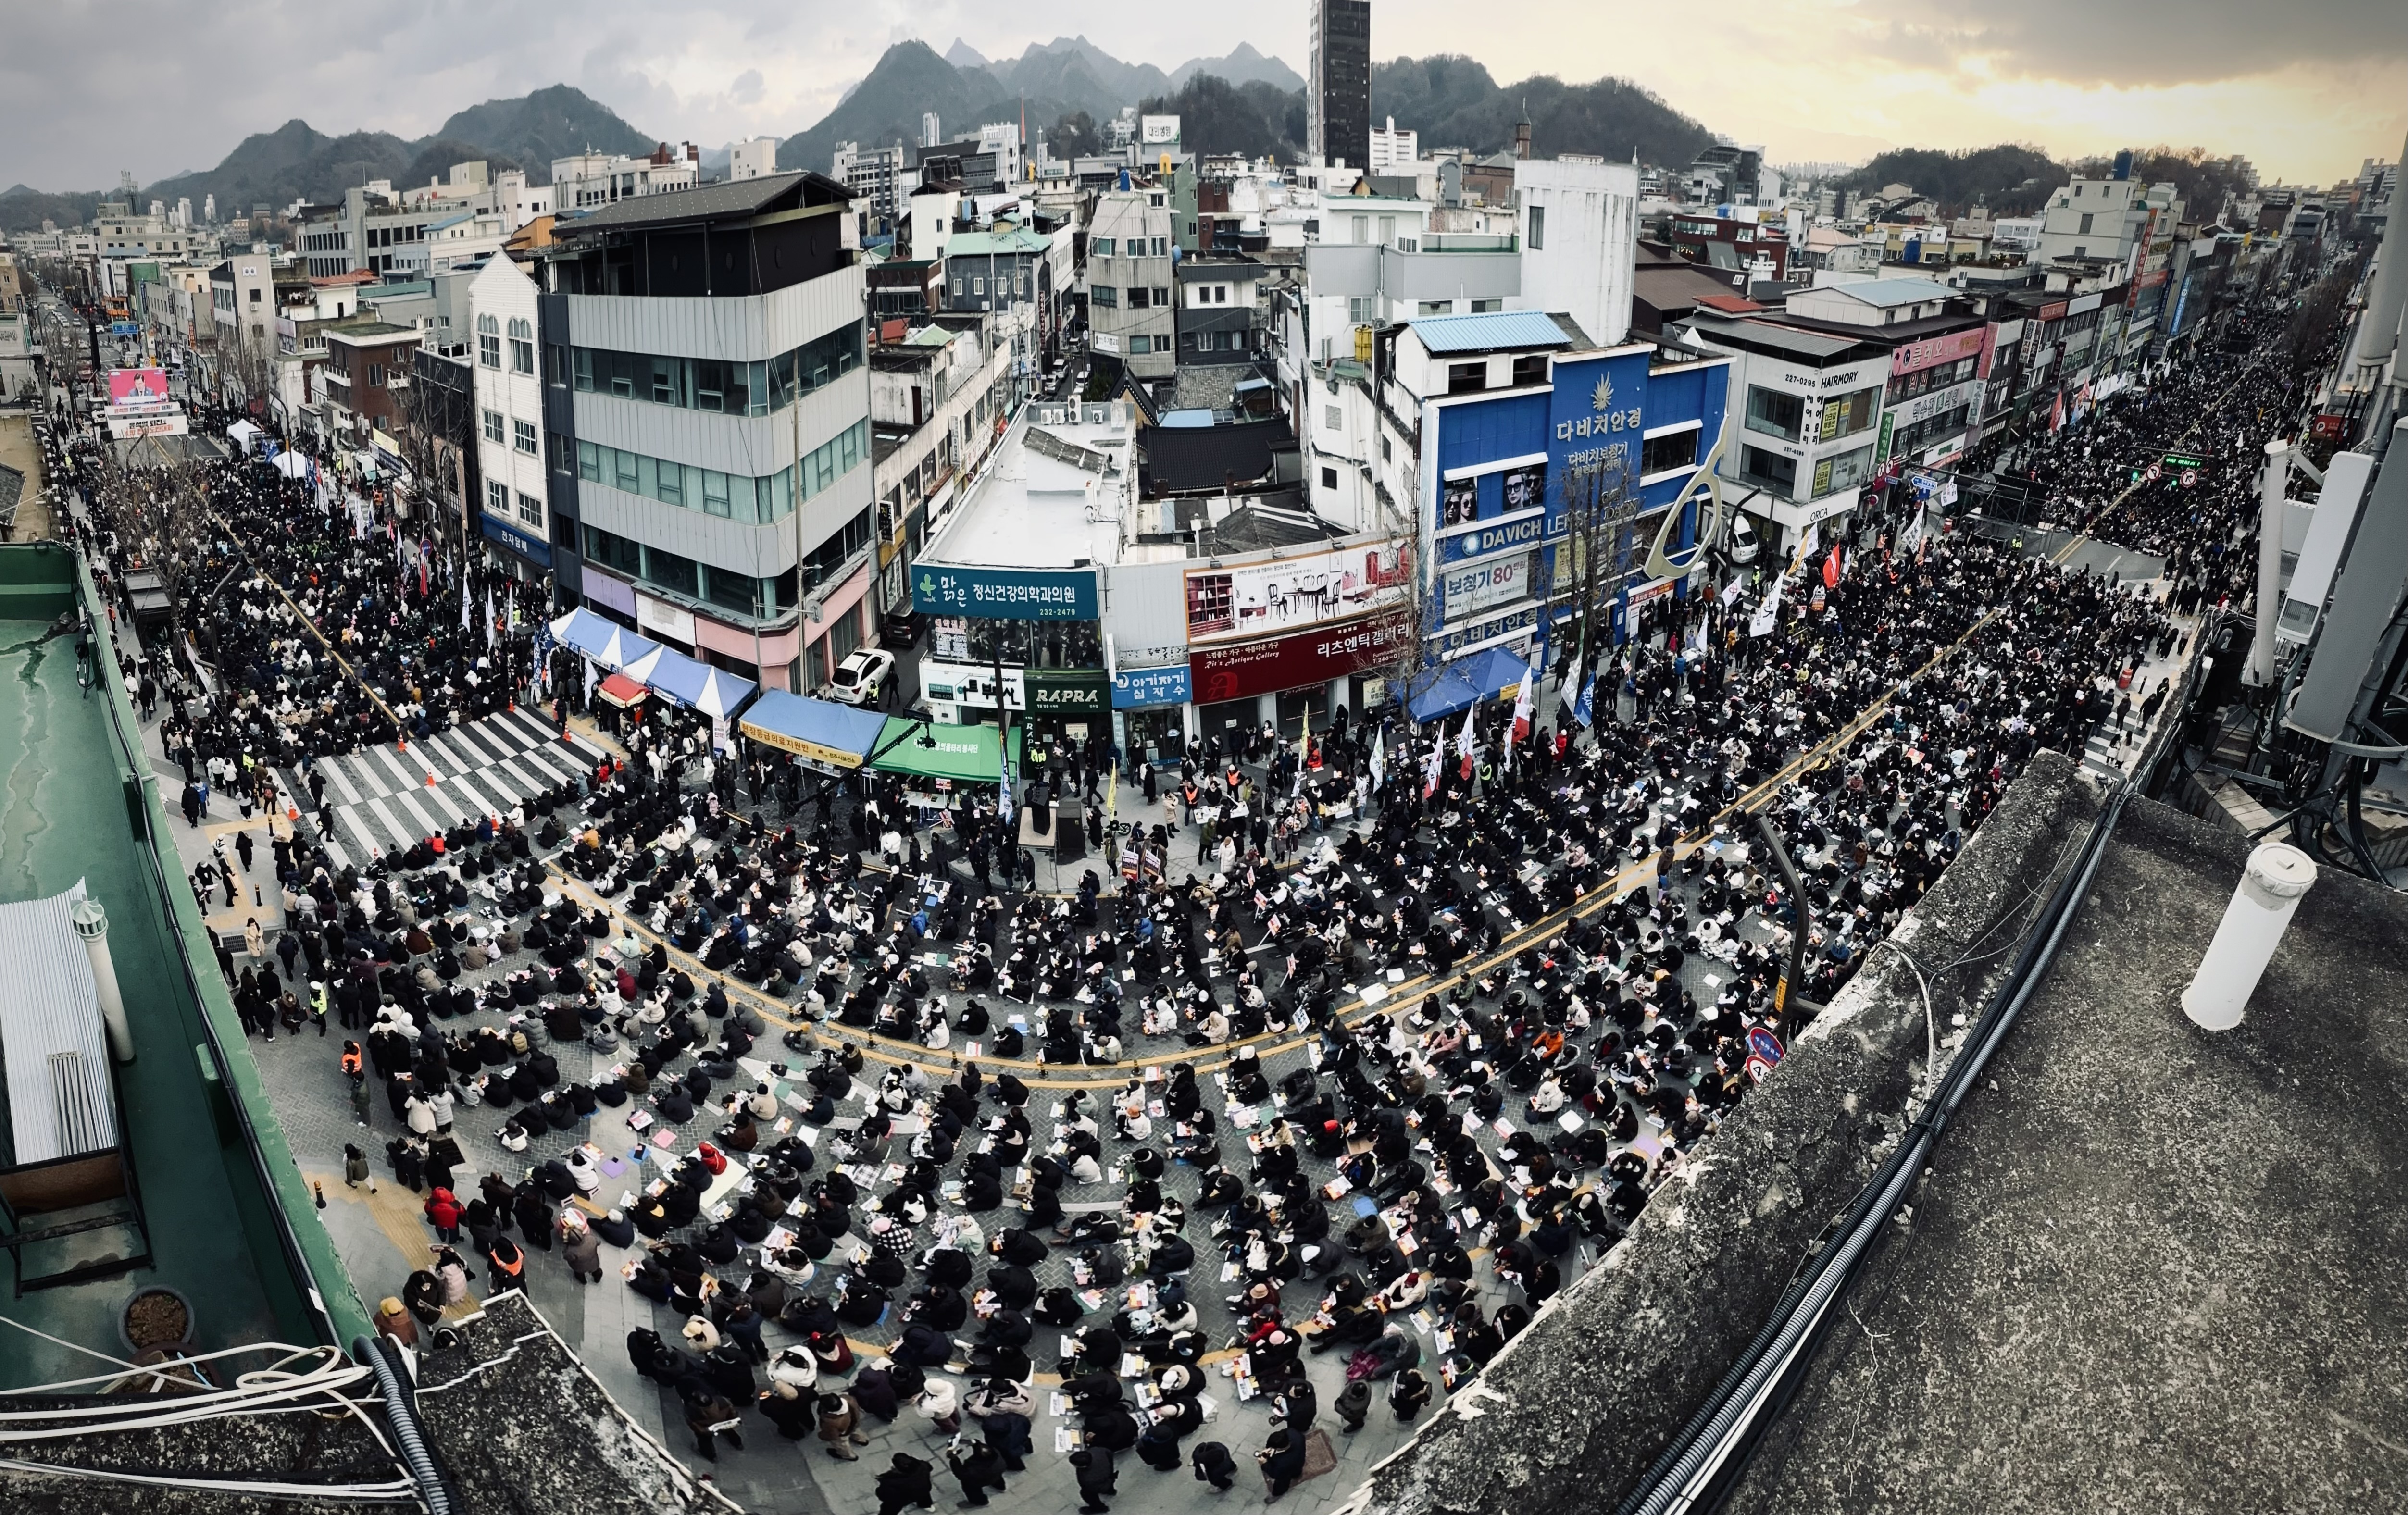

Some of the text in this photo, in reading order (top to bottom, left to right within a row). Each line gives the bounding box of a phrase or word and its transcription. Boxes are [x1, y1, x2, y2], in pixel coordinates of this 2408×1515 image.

[1912, 340, 1943, 368] 클레오
[1785, 374, 1816, 387] 227-0295
[1821, 371, 1859, 389] HAIRMORY
[1557, 407, 1641, 442] 다비치안경
[1810, 508, 1827, 522] ORCA
[502, 530, 527, 553] 전자담배
[1482, 519, 1542, 549] DAVICH
[1448, 559, 1526, 597] 보청기 80 만원
[941, 575, 1075, 608] 맑은 정신건강의학과의원
[1450, 607, 1537, 646] 다비치안경
[1206, 650, 1228, 659] 느낌좋은
[1229, 648, 1240, 656] 가구
[1245, 644, 1267, 653] 아름다운
[1317, 623, 1409, 658] 리츠엔틱갤러리
[1225, 655, 1254, 666] Antique
[1256, 651, 1279, 661] Gallery
[1132, 671, 1185, 687] 아기자기
[1036, 689, 1098, 702] RAPRA
[1134, 685, 1185, 700] 십자수
[742, 723, 809, 753] 현장응급의료지원반
